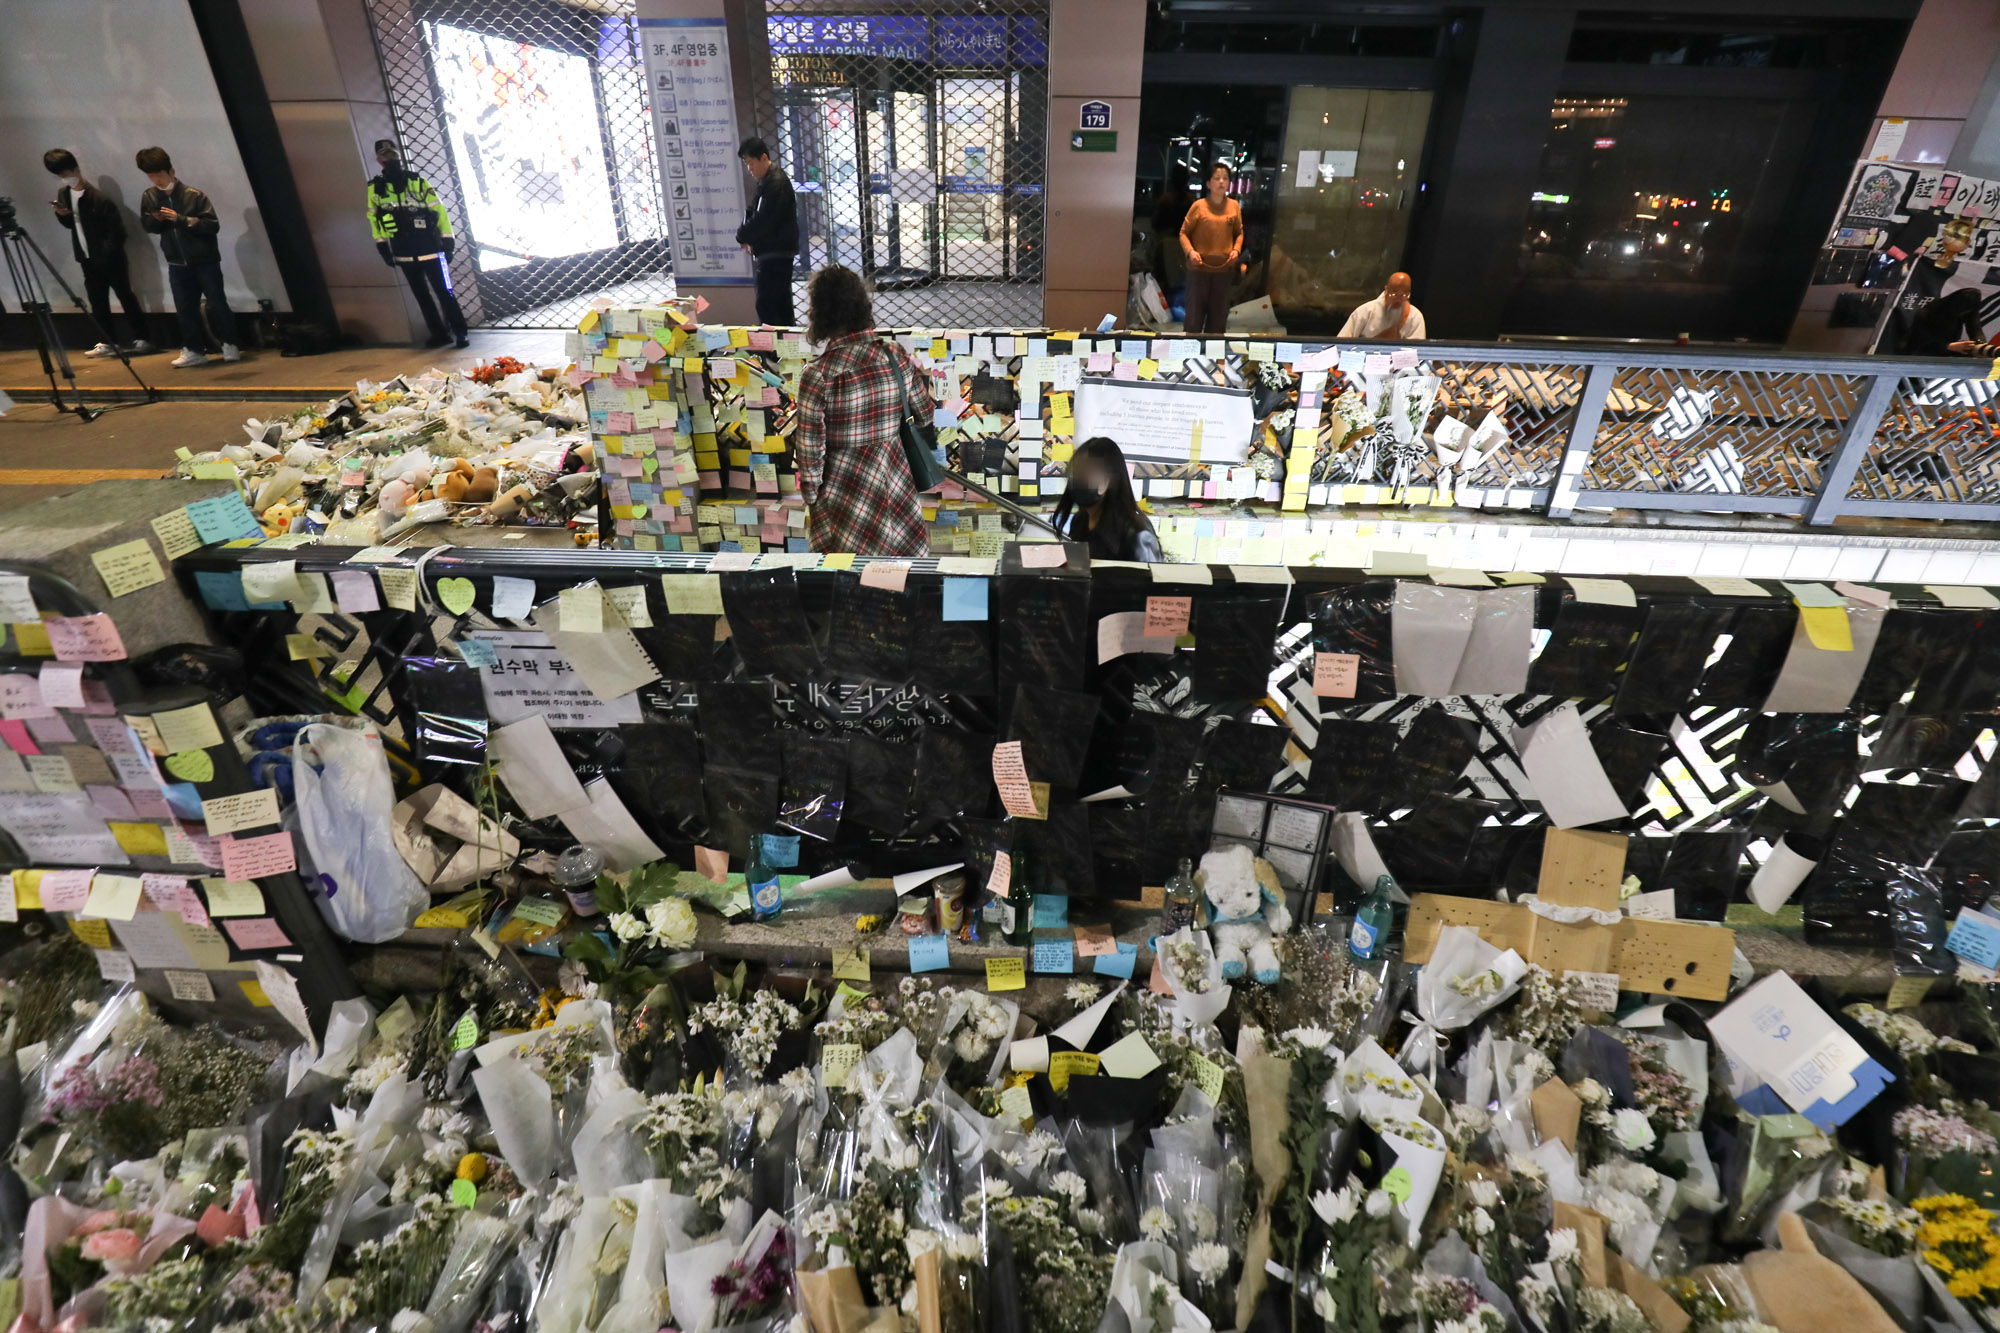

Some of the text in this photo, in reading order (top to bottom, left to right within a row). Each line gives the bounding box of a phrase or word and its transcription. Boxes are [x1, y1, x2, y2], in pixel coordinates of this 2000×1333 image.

[822, 21, 870, 43] 쇼핑몰
[653, 43, 718, 56] 3F, 4F 영업중
[1086, 115, 1106, 126] 179
